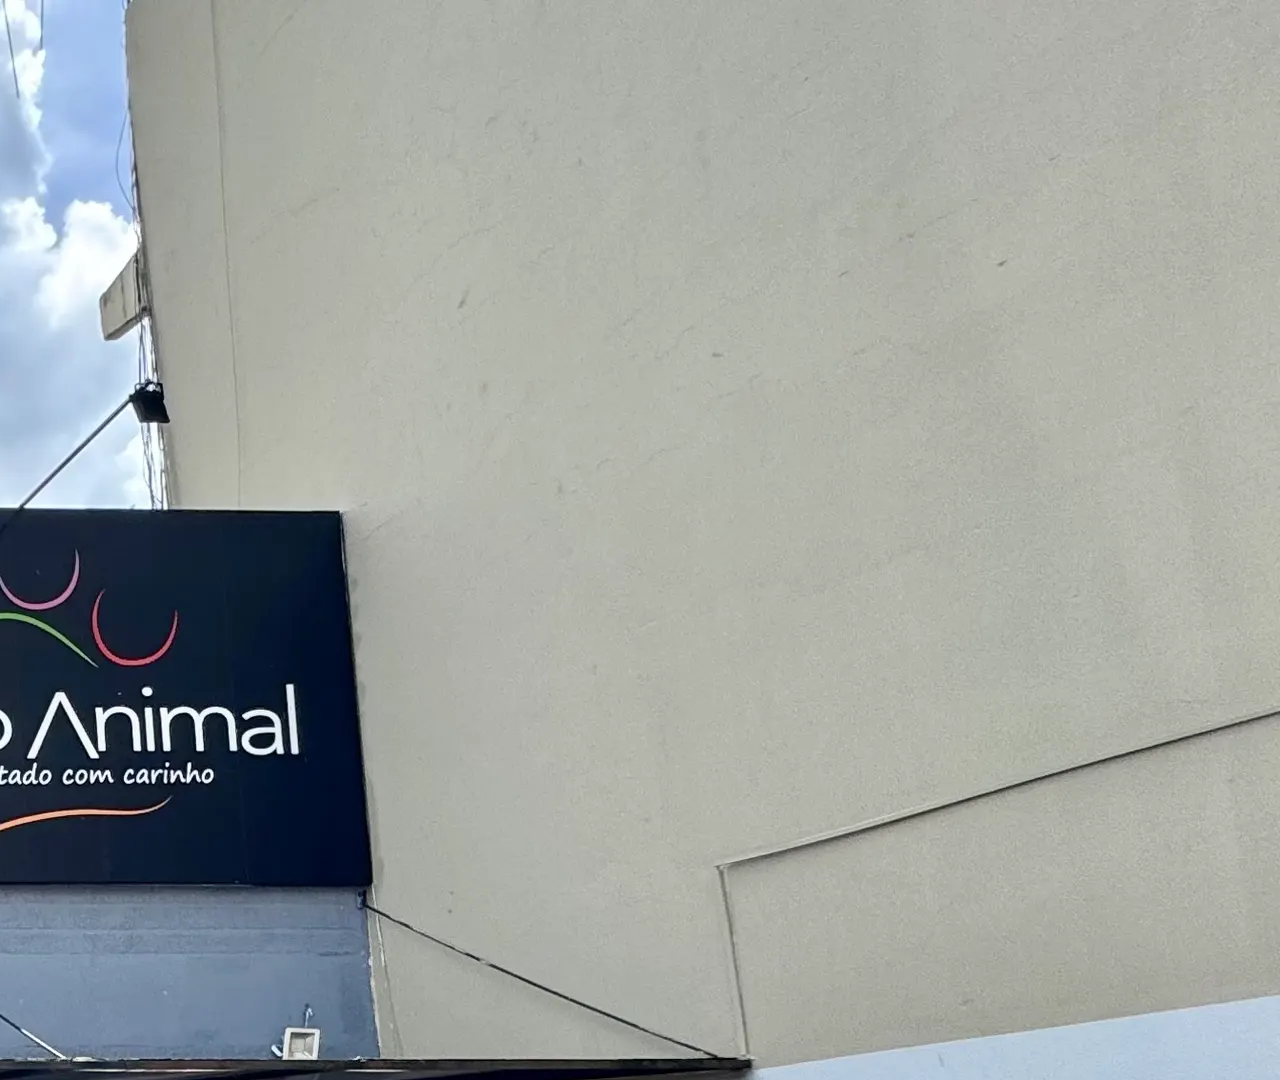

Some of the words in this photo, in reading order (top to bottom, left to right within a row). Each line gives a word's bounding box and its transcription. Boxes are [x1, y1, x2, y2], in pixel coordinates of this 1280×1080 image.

[26, 683, 300, 759] Animal
[62, 767, 115, 785] com
[123, 762, 215, 785] carinho
